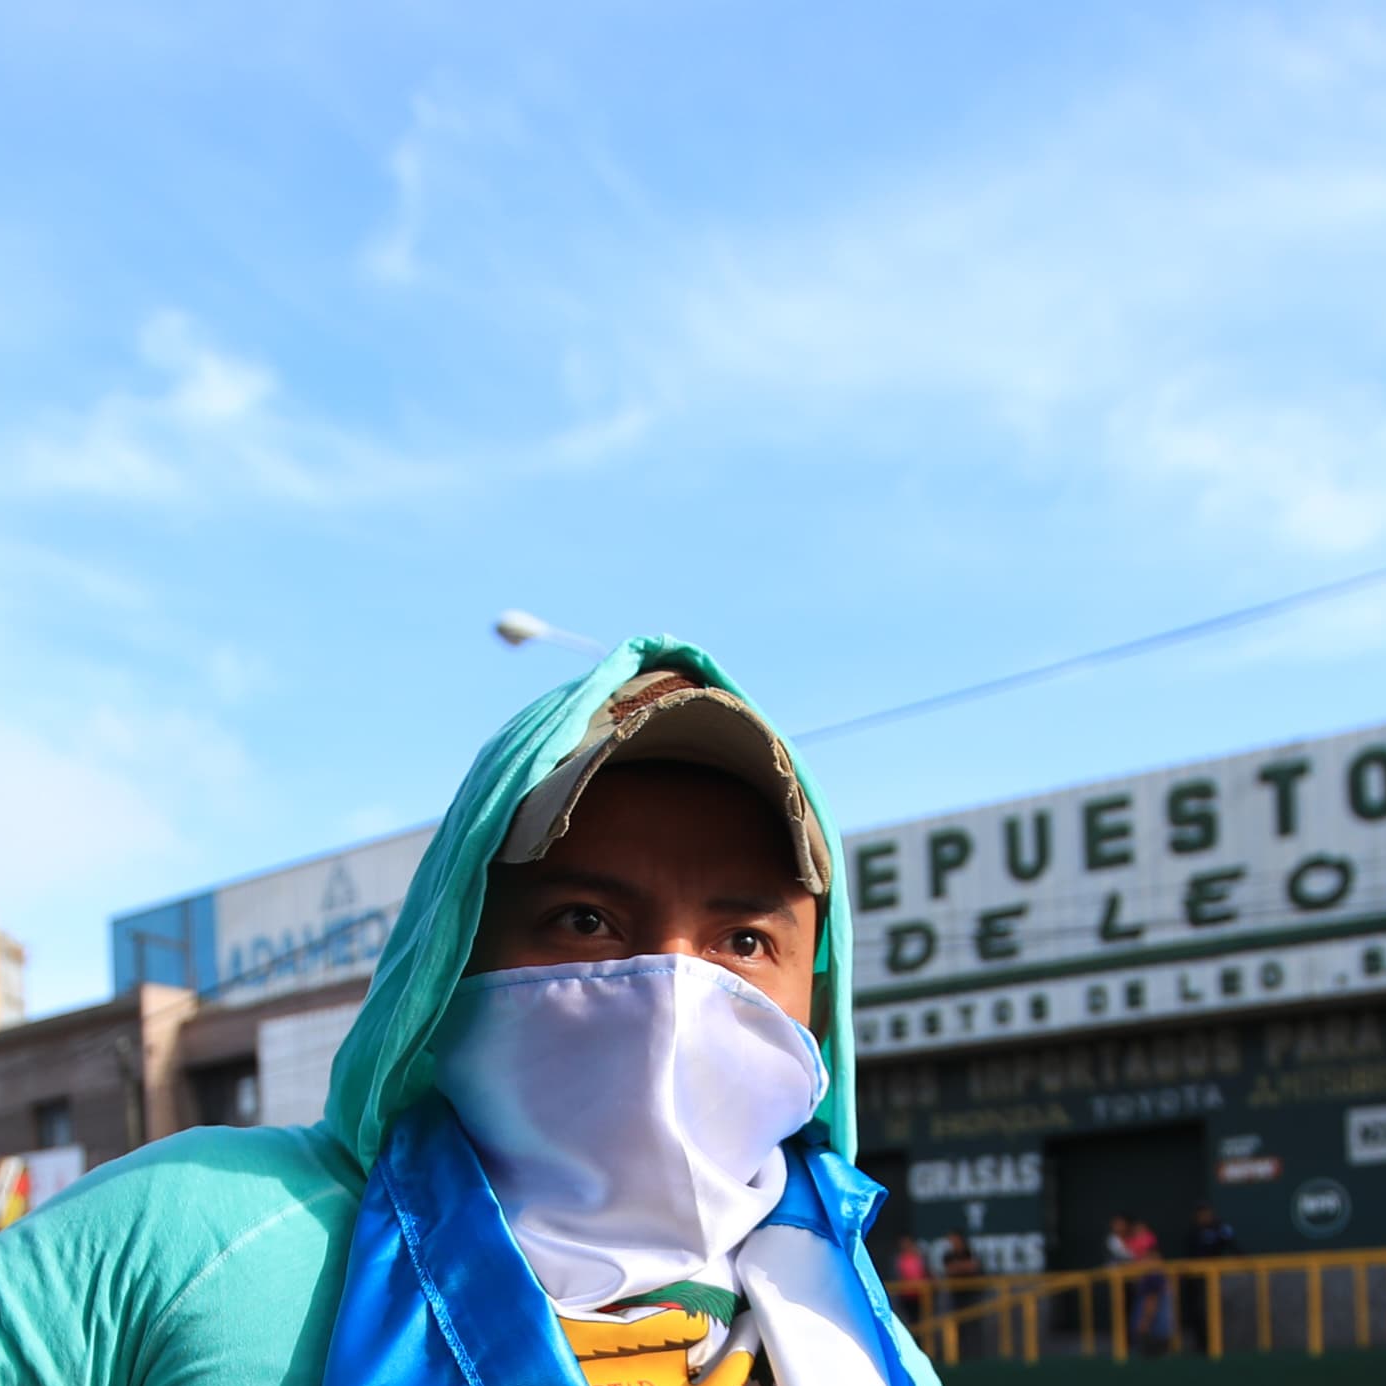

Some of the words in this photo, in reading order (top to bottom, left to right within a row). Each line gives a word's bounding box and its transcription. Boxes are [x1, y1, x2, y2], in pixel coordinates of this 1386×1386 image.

[885, 903, 1027, 975] DE
[858, 993, 1049, 1045] UESTOS
[1091, 1082, 1225, 1124] TOYOTA
[908, 1152, 1044, 1202] GRASAS
